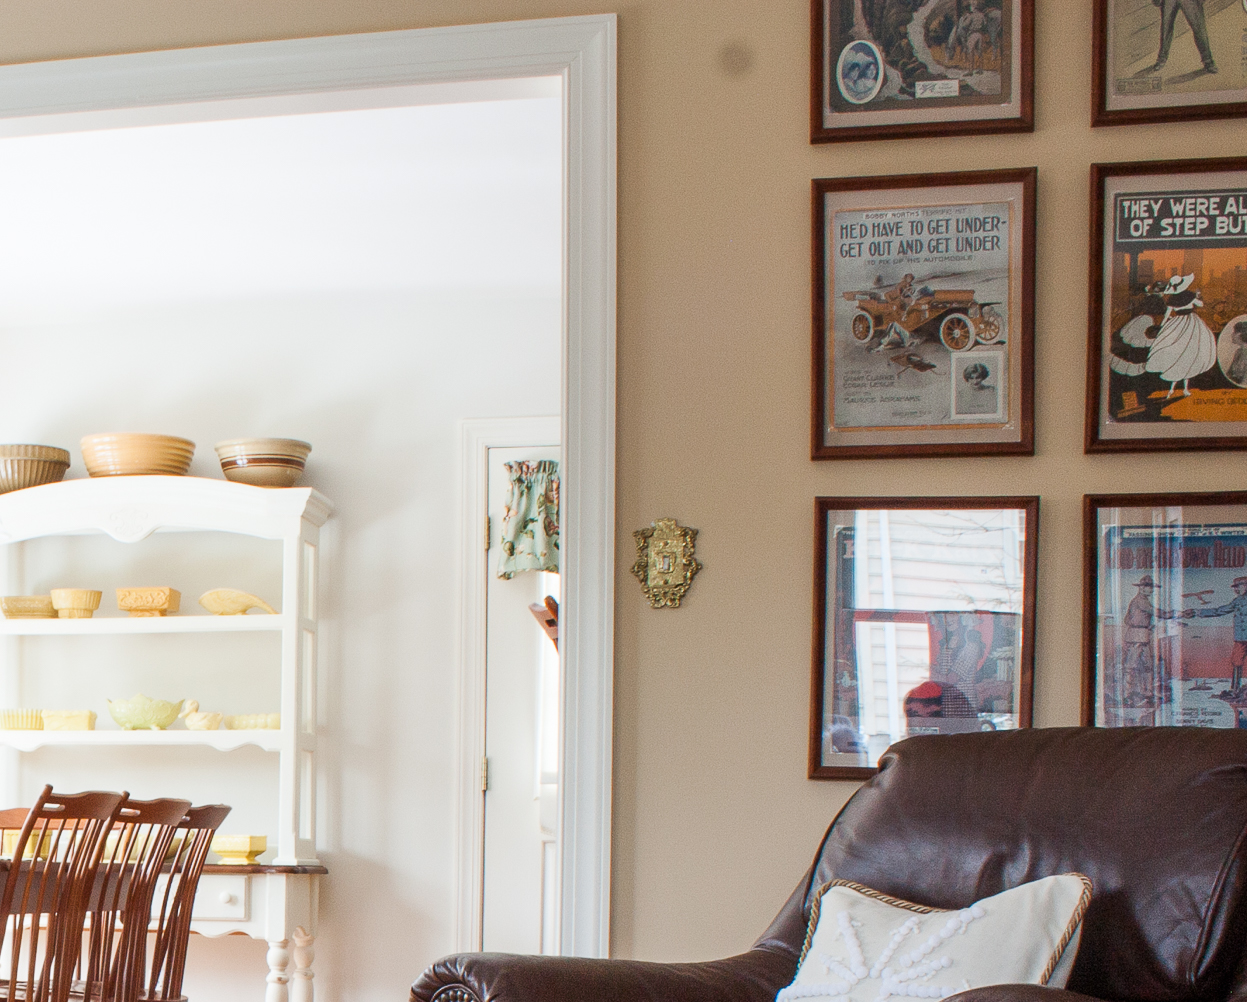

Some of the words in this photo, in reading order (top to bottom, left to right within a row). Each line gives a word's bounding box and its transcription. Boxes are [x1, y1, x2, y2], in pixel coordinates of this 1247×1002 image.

[1122, 198, 1163, 218] THEY
[1170, 197, 1220, 217] WERE
[840, 223, 868, 239] HE'D
[871, 221, 904, 238] HAVE
[908, 220, 924, 236] TO
[927, 218, 952, 235] GET
[955, 215, 1007, 234] UNDER-
[1130, 218, 1154, 237] OF
[1160, 216, 1209, 236] STEP
[1215, 215, 1247, 235] BUT
[840, 242, 864, 259] GET
[868, 240, 893, 257] OUT
[897, 239, 924, 256] AND
[927, 237, 952, 254] GET
[955, 235, 1001, 253] UNDER
